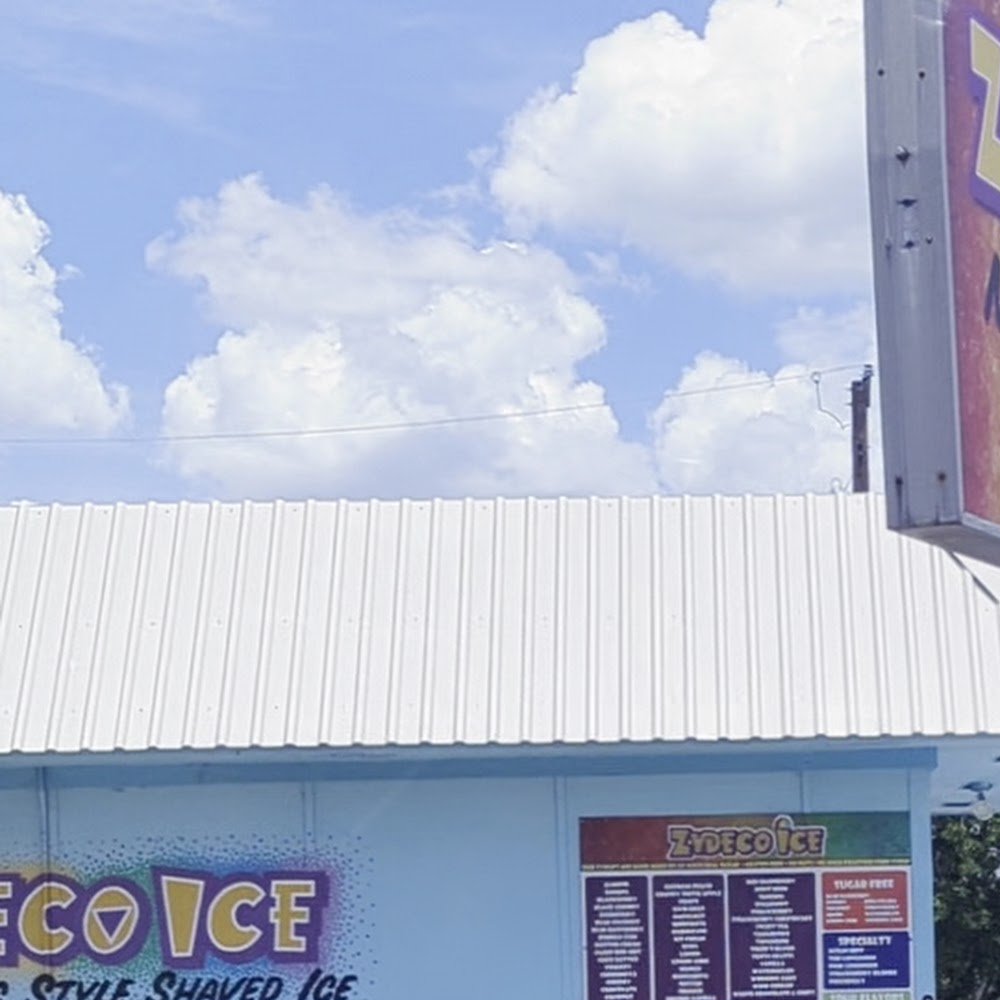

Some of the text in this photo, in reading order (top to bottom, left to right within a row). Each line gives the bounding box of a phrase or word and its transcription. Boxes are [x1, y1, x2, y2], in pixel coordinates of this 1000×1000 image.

[669, 818, 826, 859] ZYDECO ICE
[0, 875, 316, 958] CO ICE
